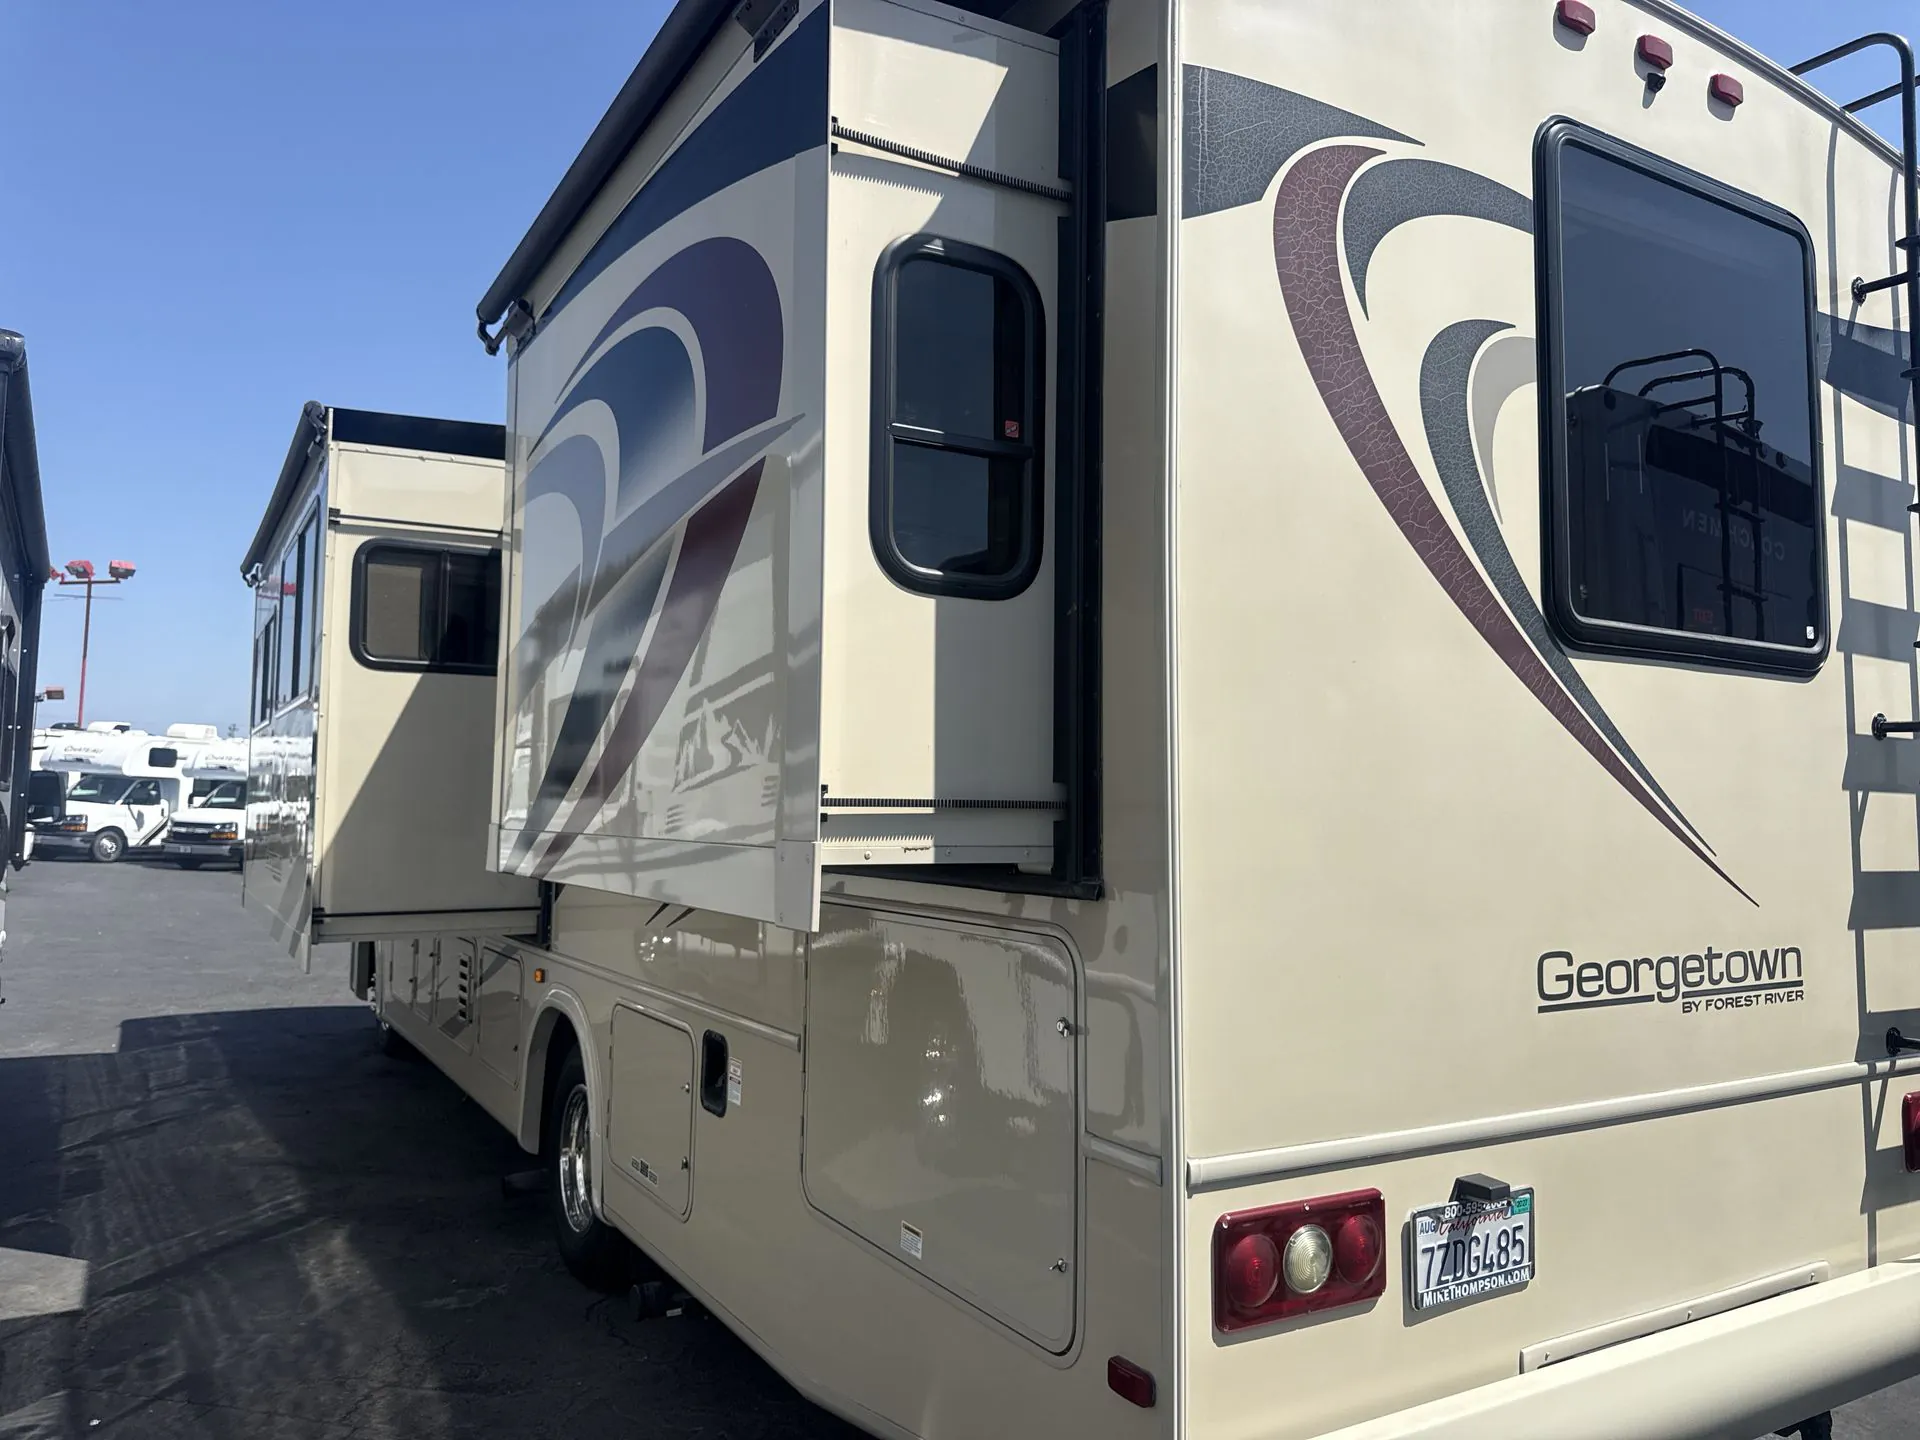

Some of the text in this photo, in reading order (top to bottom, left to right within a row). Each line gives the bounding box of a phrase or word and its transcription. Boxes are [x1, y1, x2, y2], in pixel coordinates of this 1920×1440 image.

[1537, 946, 1802, 1003] Georgetown
[1682, 989, 1805, 1014] BY FOREST RIVER
[1419, 1221, 1437, 1236] AUG
[1421, 1224, 1525, 1290] 7ZDG485
